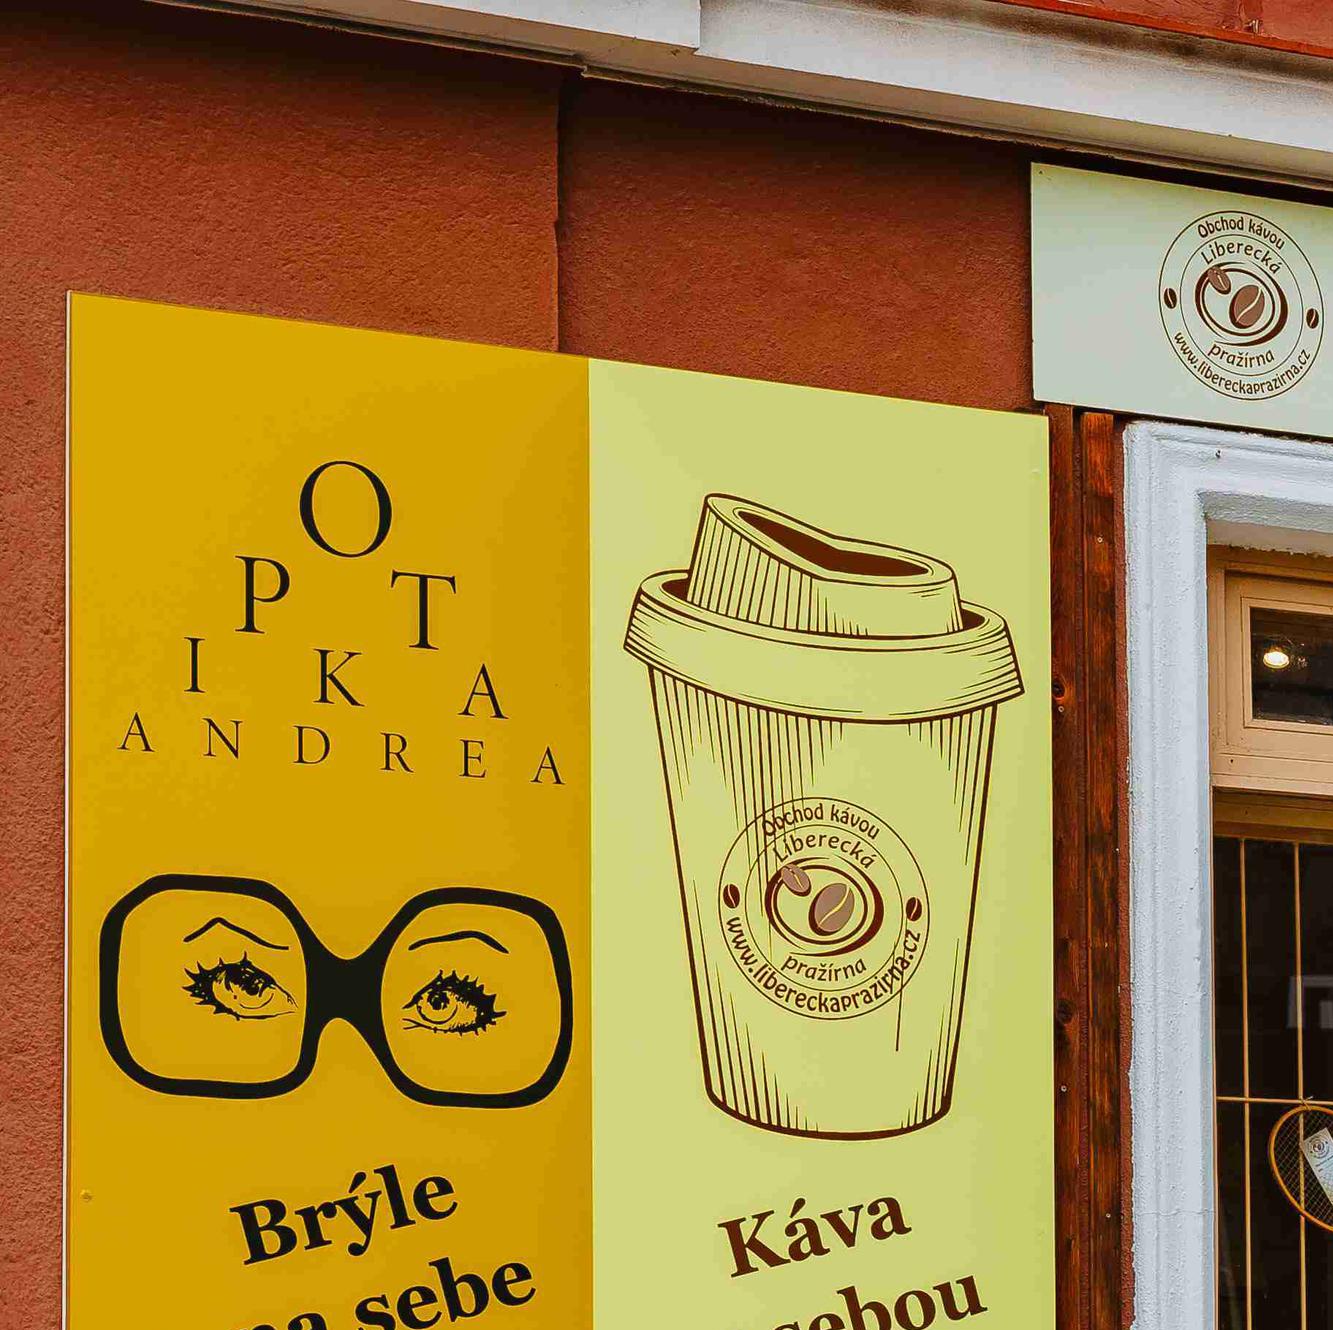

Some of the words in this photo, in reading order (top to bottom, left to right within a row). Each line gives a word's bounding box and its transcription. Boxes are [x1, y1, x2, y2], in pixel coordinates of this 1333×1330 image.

[1197, 216, 1245, 239] Obchod
[1248, 218, 1285, 250] kávou
[1200, 241, 1283, 275] Liberecká
[1174, 331, 1311, 395] www.libereckaprazirna.cz
[1207, 341, 1275, 368] pražírna
[117, 711, 566, 786] ANDREA
[762, 802, 824, 837] Obchod
[830, 804, 880, 841] kávou
[772, 834, 877, 869] Liberecká
[726, 916, 921, 1013] www.libereckaprazirna.cz
[780, 954, 867, 982] pražírna
[229, 1164, 458, 1266] Brýle
[717, 1197, 913, 1278] Káva
